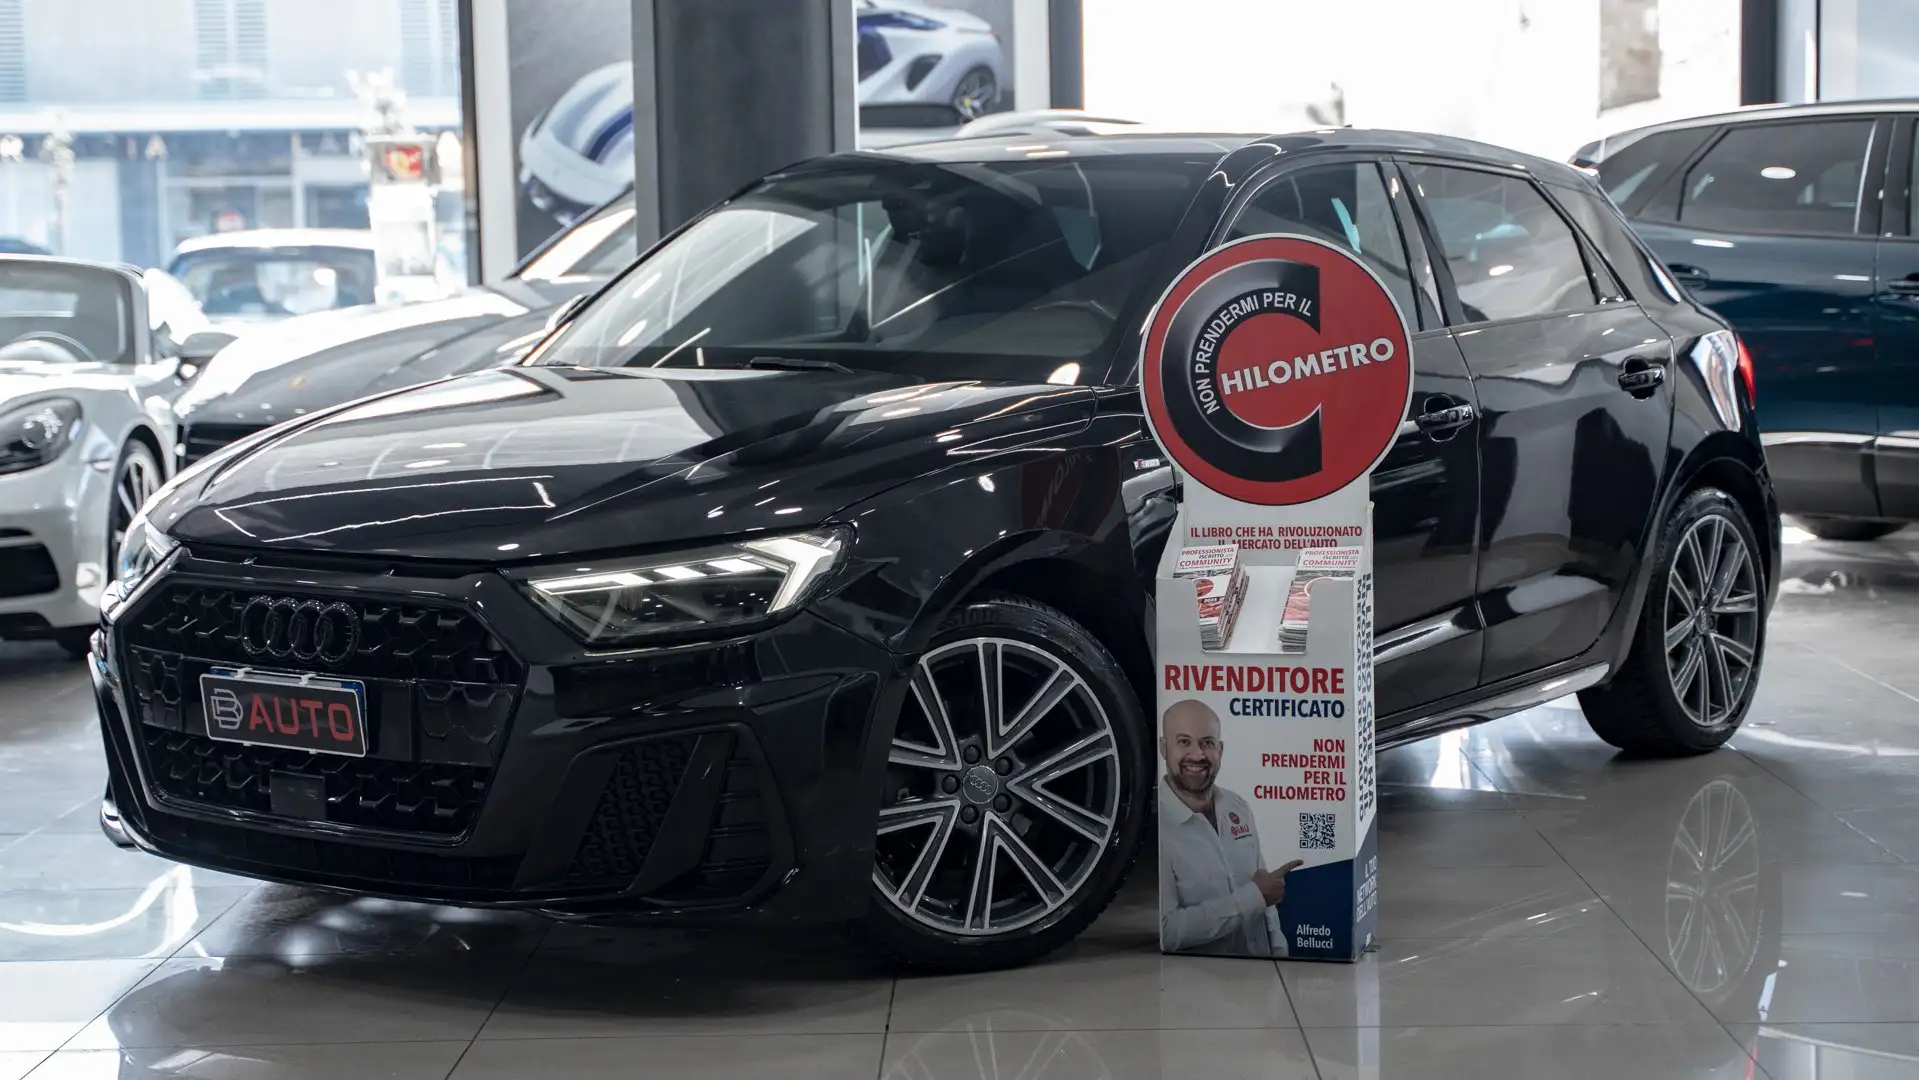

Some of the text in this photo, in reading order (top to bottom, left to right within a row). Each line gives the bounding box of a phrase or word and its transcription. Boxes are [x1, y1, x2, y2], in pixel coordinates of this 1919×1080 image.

[1195, 292, 1312, 415] NON PRENDERMI PER IL
[1191, 526, 1363, 538] IL LIBRO CHE HA RIVOLUZIONATO
[1181, 547, 1235, 556] PROFESSIONISTA
[1231, 539, 1281, 550] MERCATO
[1284, 539, 1338, 550] DELL'AUTO
[1180, 557, 1232, 567] COMMUNITY
[1365, 605, 1373, 693] LIBRO
[1164, 664, 1345, 694] RIVENDITORE
[1229, 697, 1345, 718] CERTIFICATO
[250, 692, 355, 741] AUTO
[1313, 738, 1345, 753] NON
[1262, 753, 1345, 769] PRENDERMI
[1304, 770, 1347, 785] PER IL
[1253, 784, 1346, 802] CHILOMETRO
[1296, 924, 1331, 936] Alfredo
[1297, 937, 1333, 949] Bellucci
